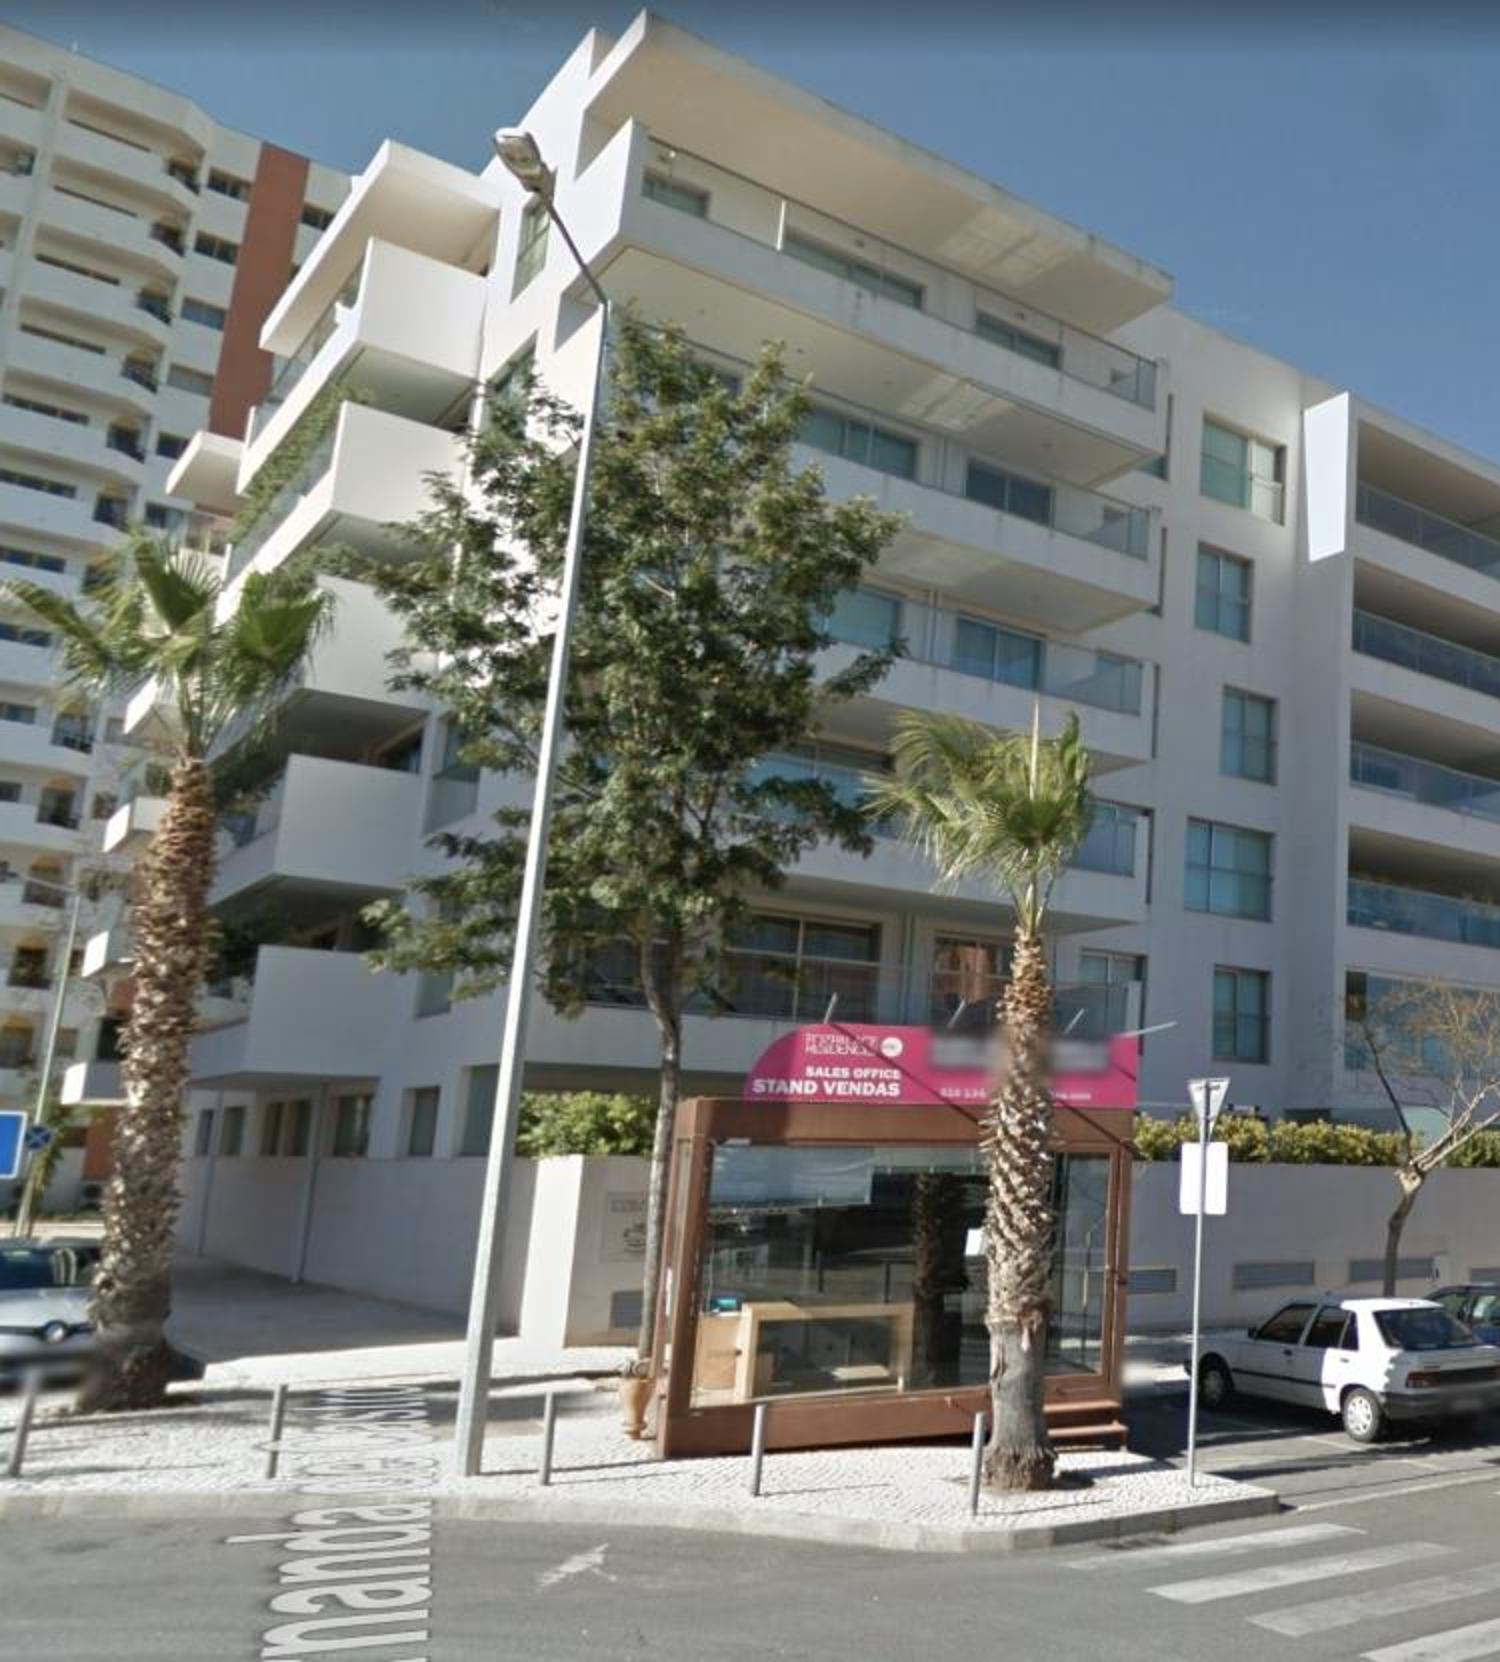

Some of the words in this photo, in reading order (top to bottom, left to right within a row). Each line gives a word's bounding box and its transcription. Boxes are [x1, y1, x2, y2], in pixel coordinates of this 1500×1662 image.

[805, 1066, 850, 1079] SALES
[853, 1068, 902, 1080] OFFICE
[752, 1079, 818, 1094] STAND
[822, 1081, 902, 1097] VENDAS
